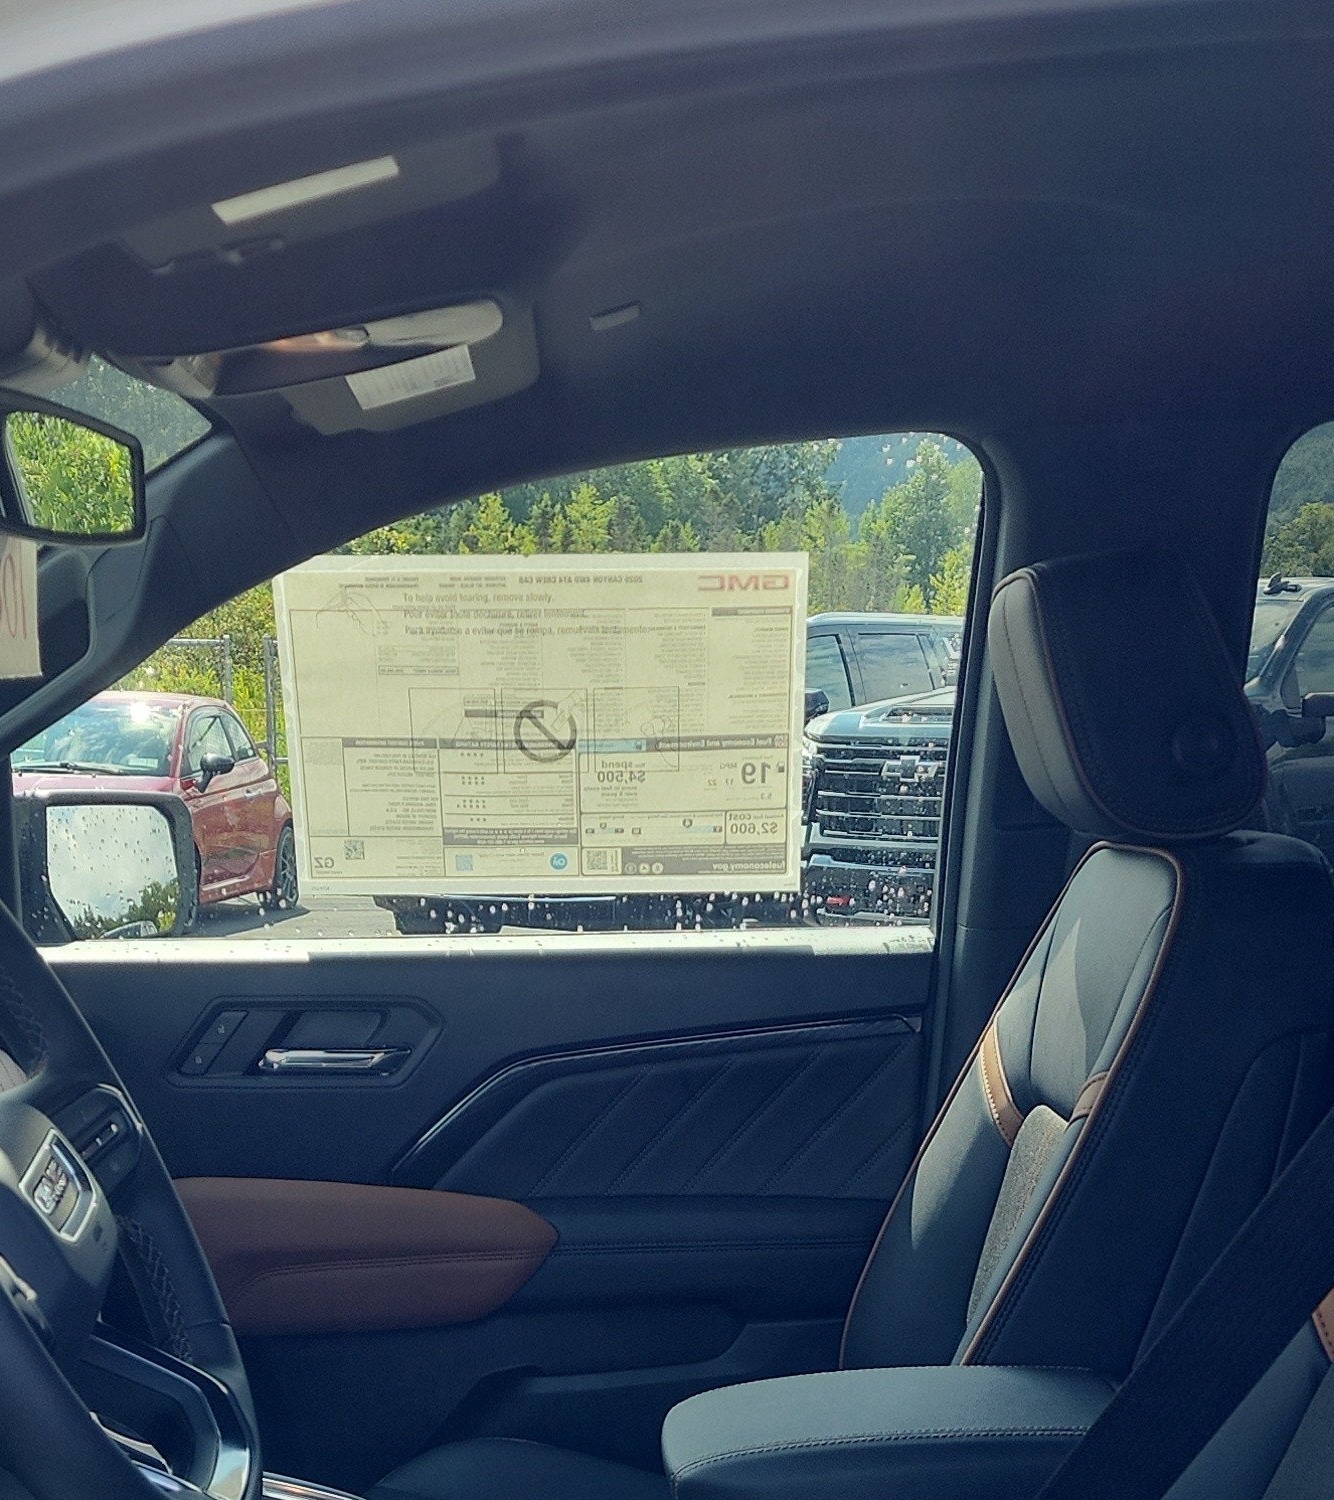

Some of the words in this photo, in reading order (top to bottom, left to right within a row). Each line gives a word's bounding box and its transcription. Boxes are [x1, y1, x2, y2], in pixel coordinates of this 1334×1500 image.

[403, 592, 414, 602] To
[416, 592, 433, 604] help
[435, 592, 458, 602] avoid
[493, 593, 523, 602] remove
[525, 592, 555, 604] slowly.
